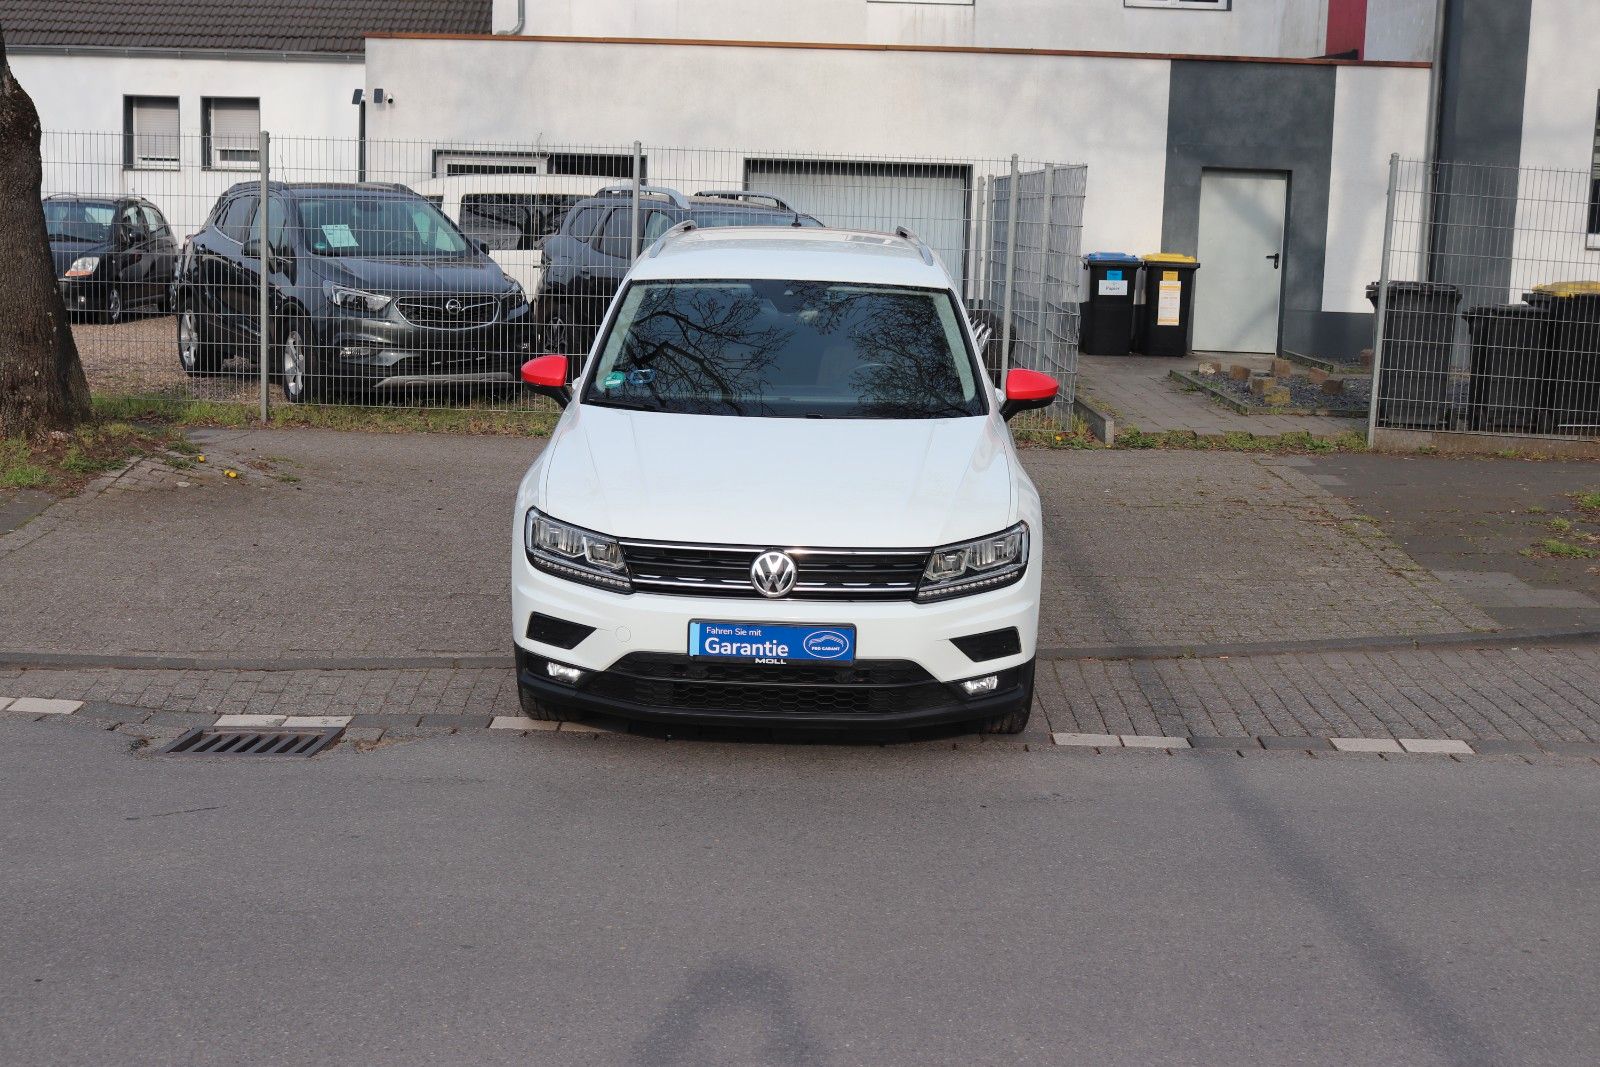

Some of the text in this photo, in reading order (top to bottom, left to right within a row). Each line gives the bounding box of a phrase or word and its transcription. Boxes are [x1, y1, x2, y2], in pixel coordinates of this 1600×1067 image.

[706, 626, 733, 636] Fahren
[735, 628, 747, 636] Sie
[704, 637, 789, 657] Garantie
